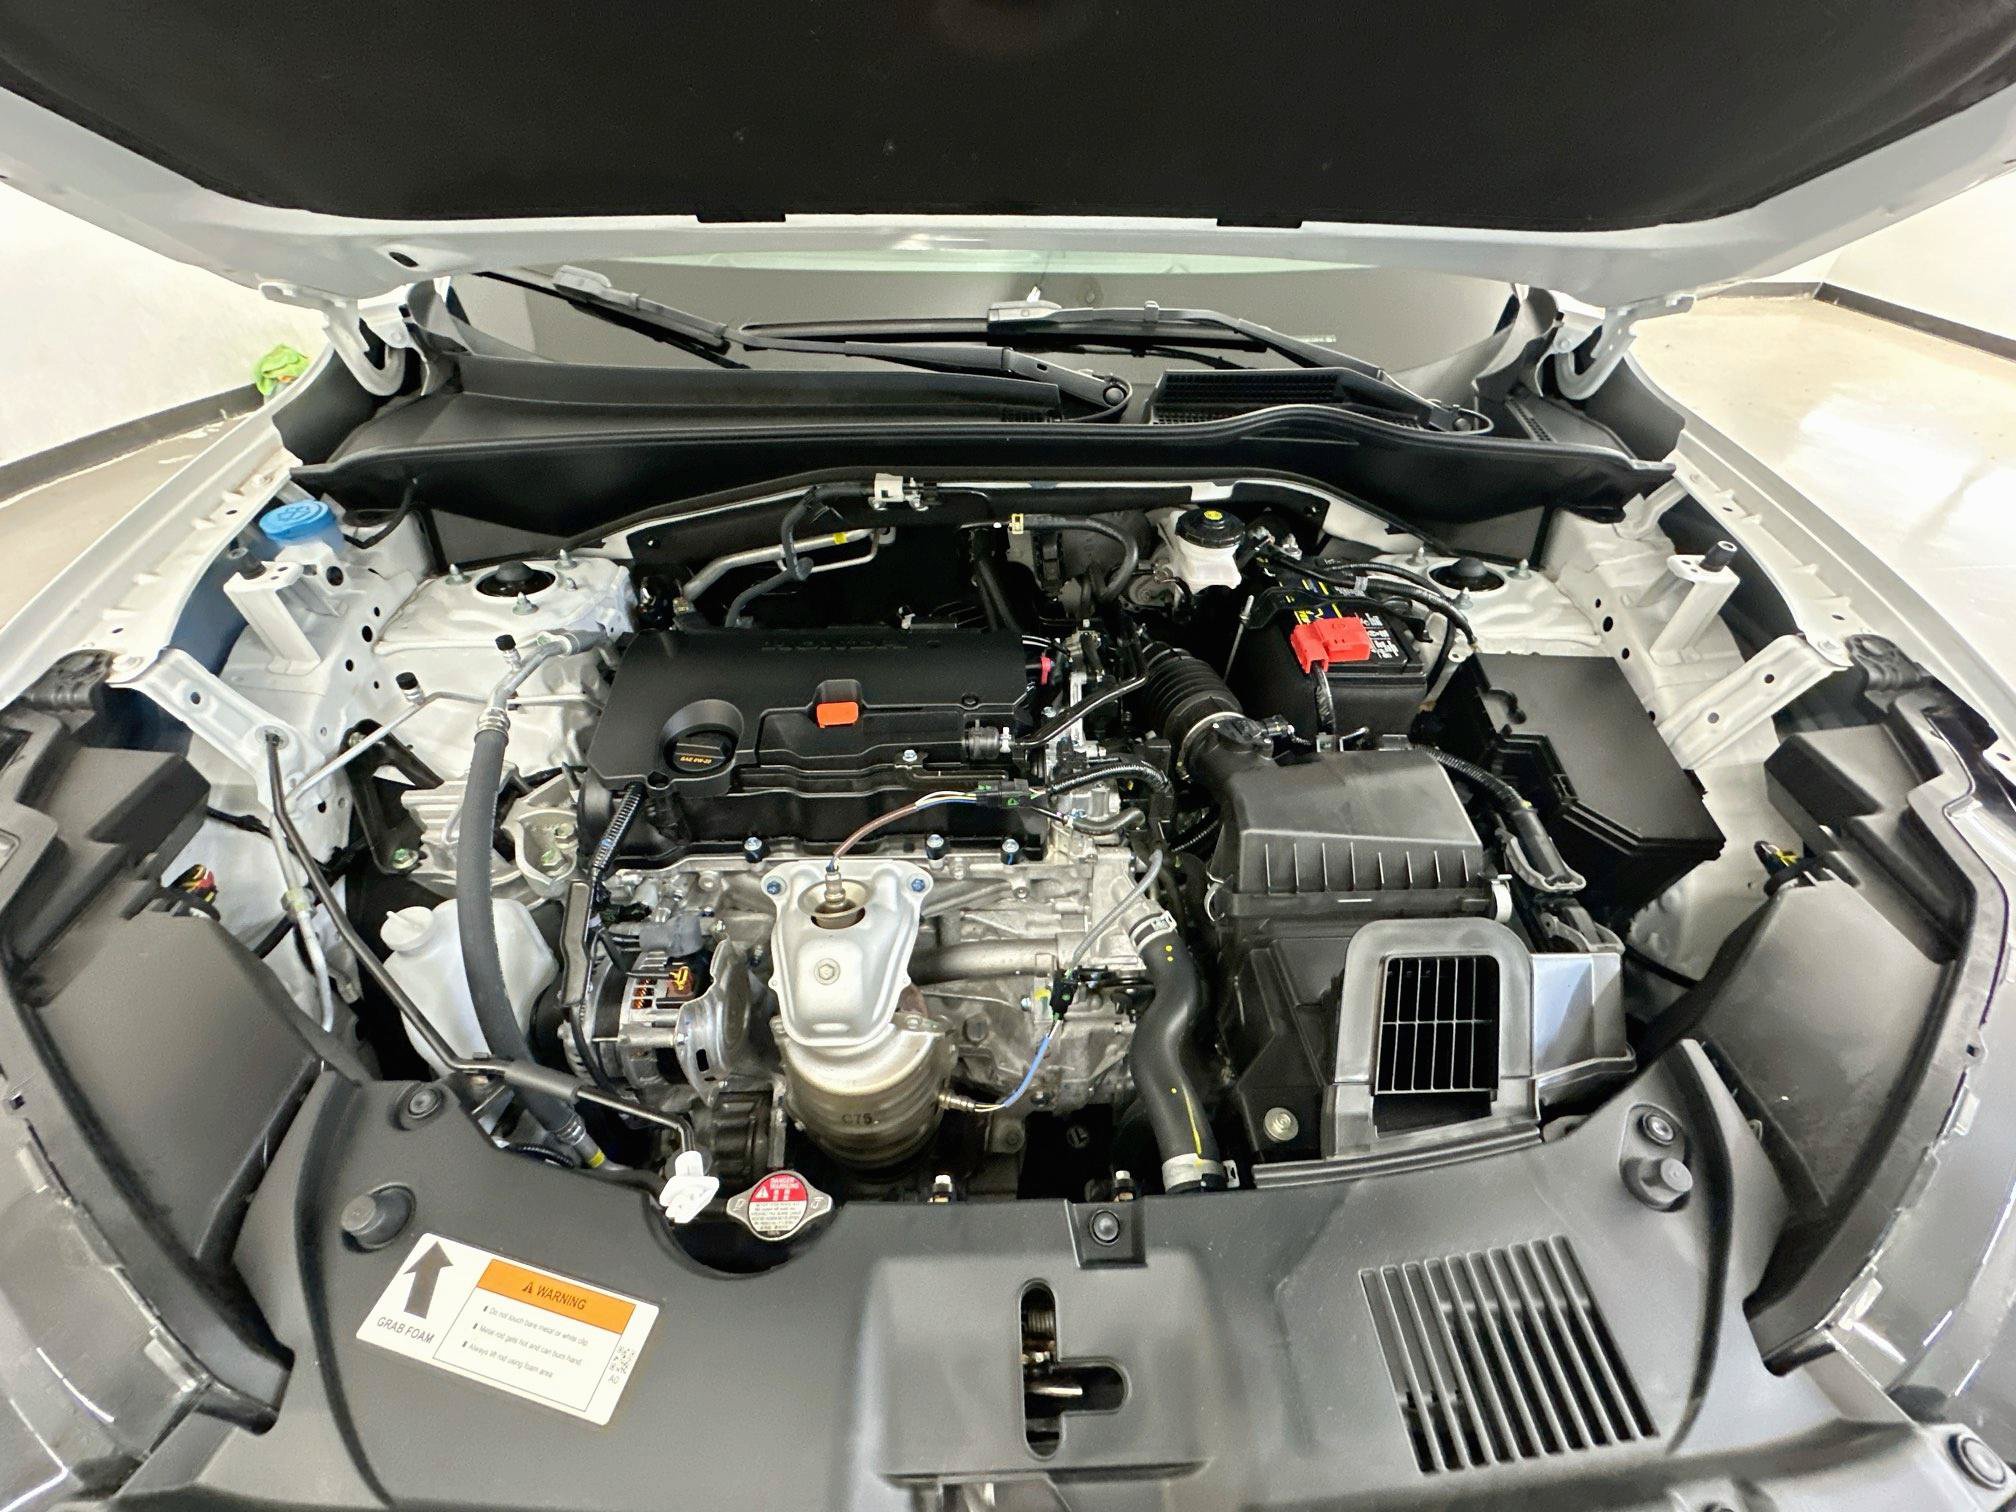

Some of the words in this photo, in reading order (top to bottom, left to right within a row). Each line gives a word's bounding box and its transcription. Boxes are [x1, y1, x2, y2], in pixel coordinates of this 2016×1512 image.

[537, 1284, 587, 1310] WARNING
[377, 1316, 406, 1334] GRAB
[405, 1325, 435, 1344] FOAM
